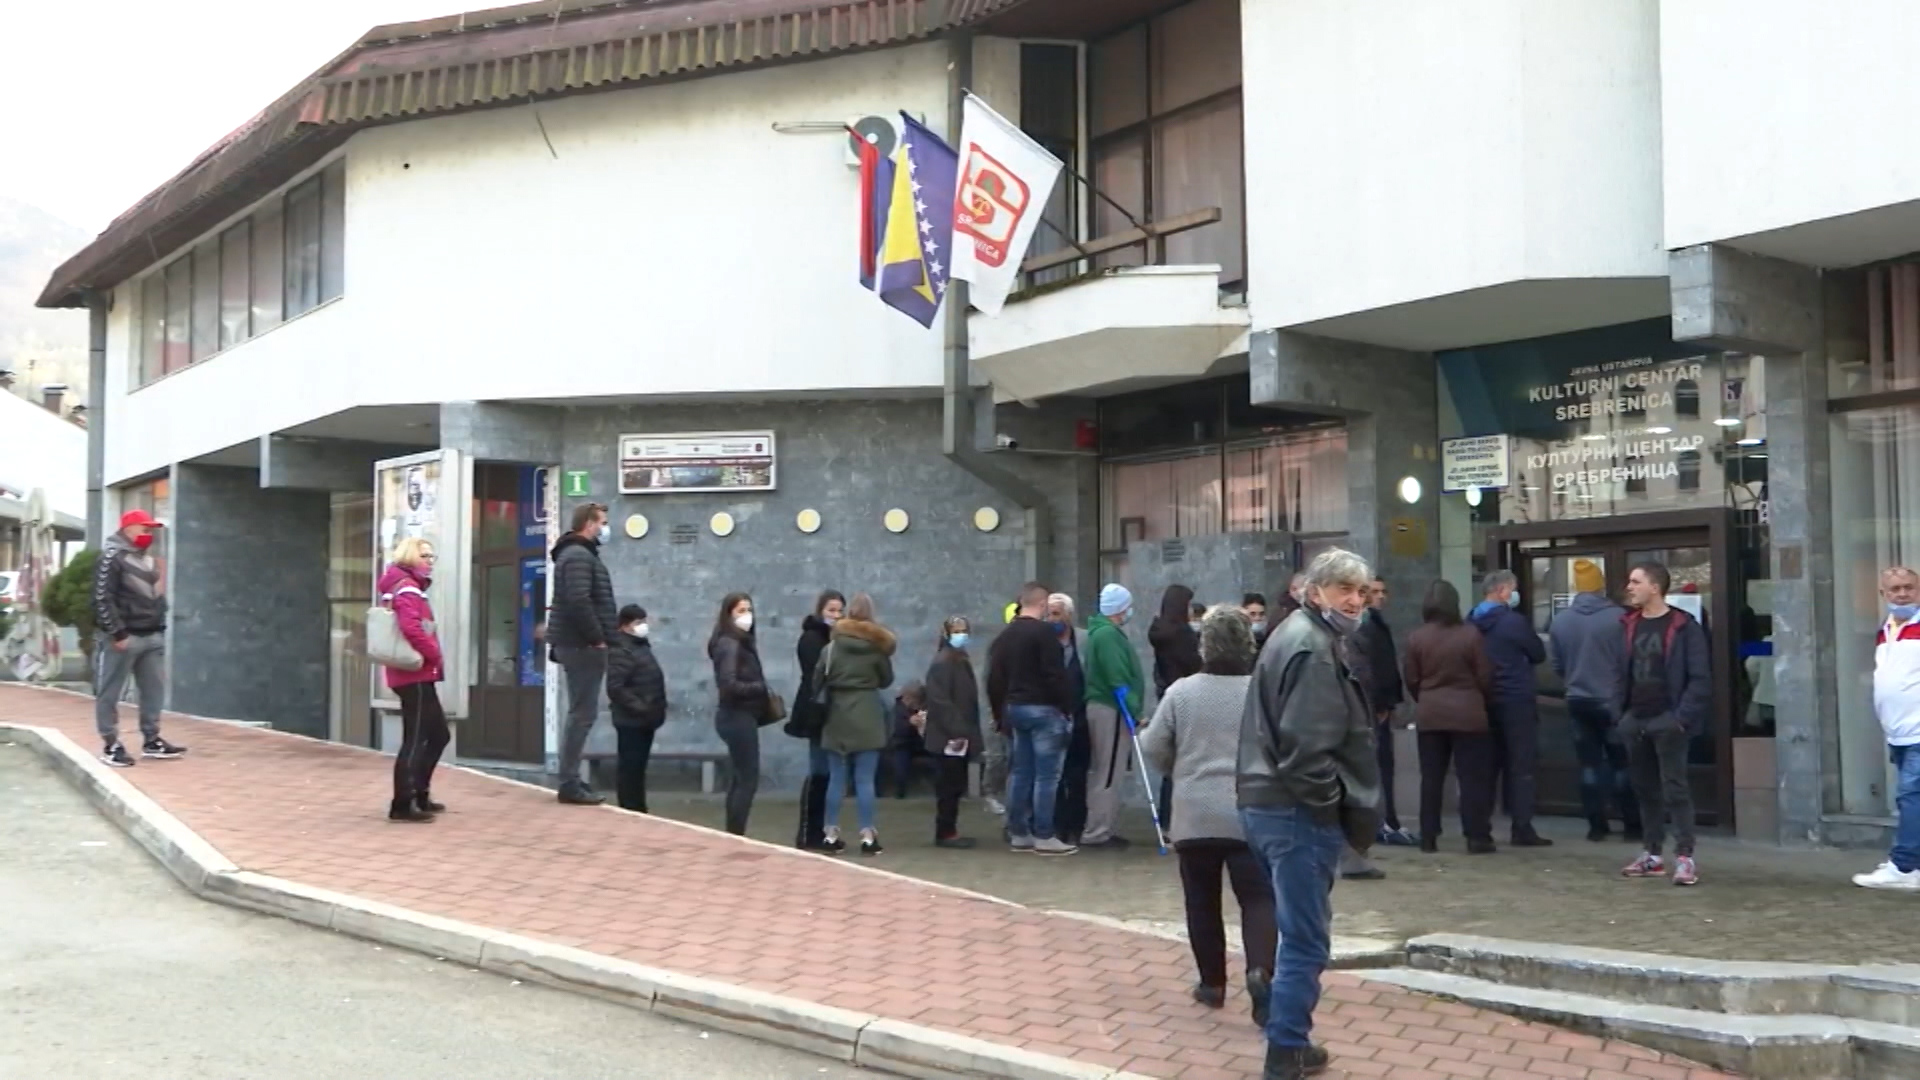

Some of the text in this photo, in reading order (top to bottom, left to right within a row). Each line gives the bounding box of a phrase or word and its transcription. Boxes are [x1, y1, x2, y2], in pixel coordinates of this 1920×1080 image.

[1529, 364, 1702, 404] KULTURNI CENTAR
[1555, 391, 1673, 421] SREBRENICA
[1527, 446, 1619, 470] КУЛТУРНИ
[1626, 435, 1704, 457] ЦЕНТАР
[1553, 461, 1679, 488] СРЕБРЕНИЦА
